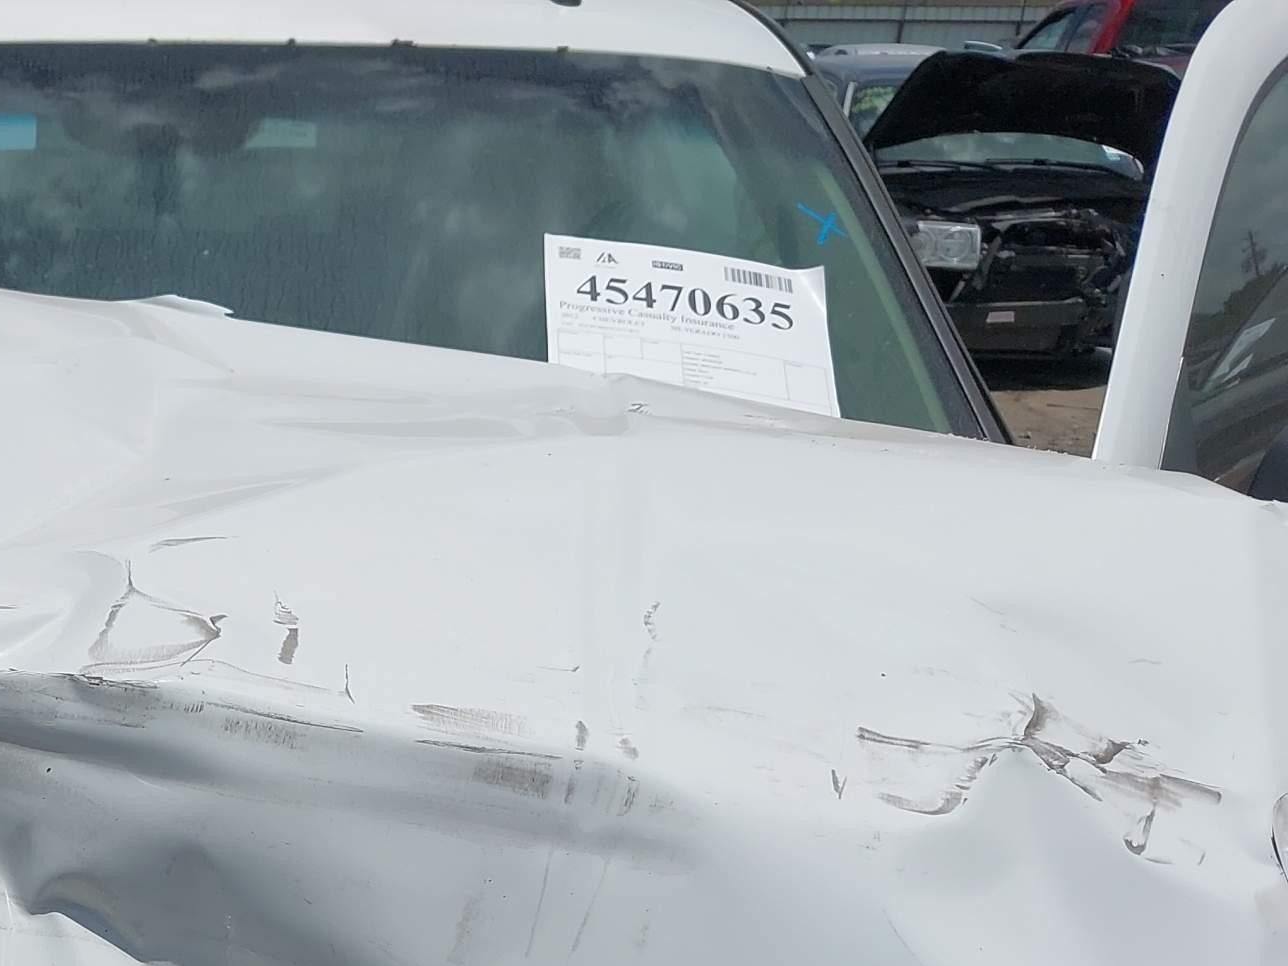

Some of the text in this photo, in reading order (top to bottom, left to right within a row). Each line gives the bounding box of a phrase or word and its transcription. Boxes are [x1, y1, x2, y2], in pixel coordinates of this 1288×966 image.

[559, 300, 625, 317] Progressive
[628, 307, 677, 323] Casualty
[680, 315, 735, 331] Insurance
[576, 275, 794, 331] 45470635
